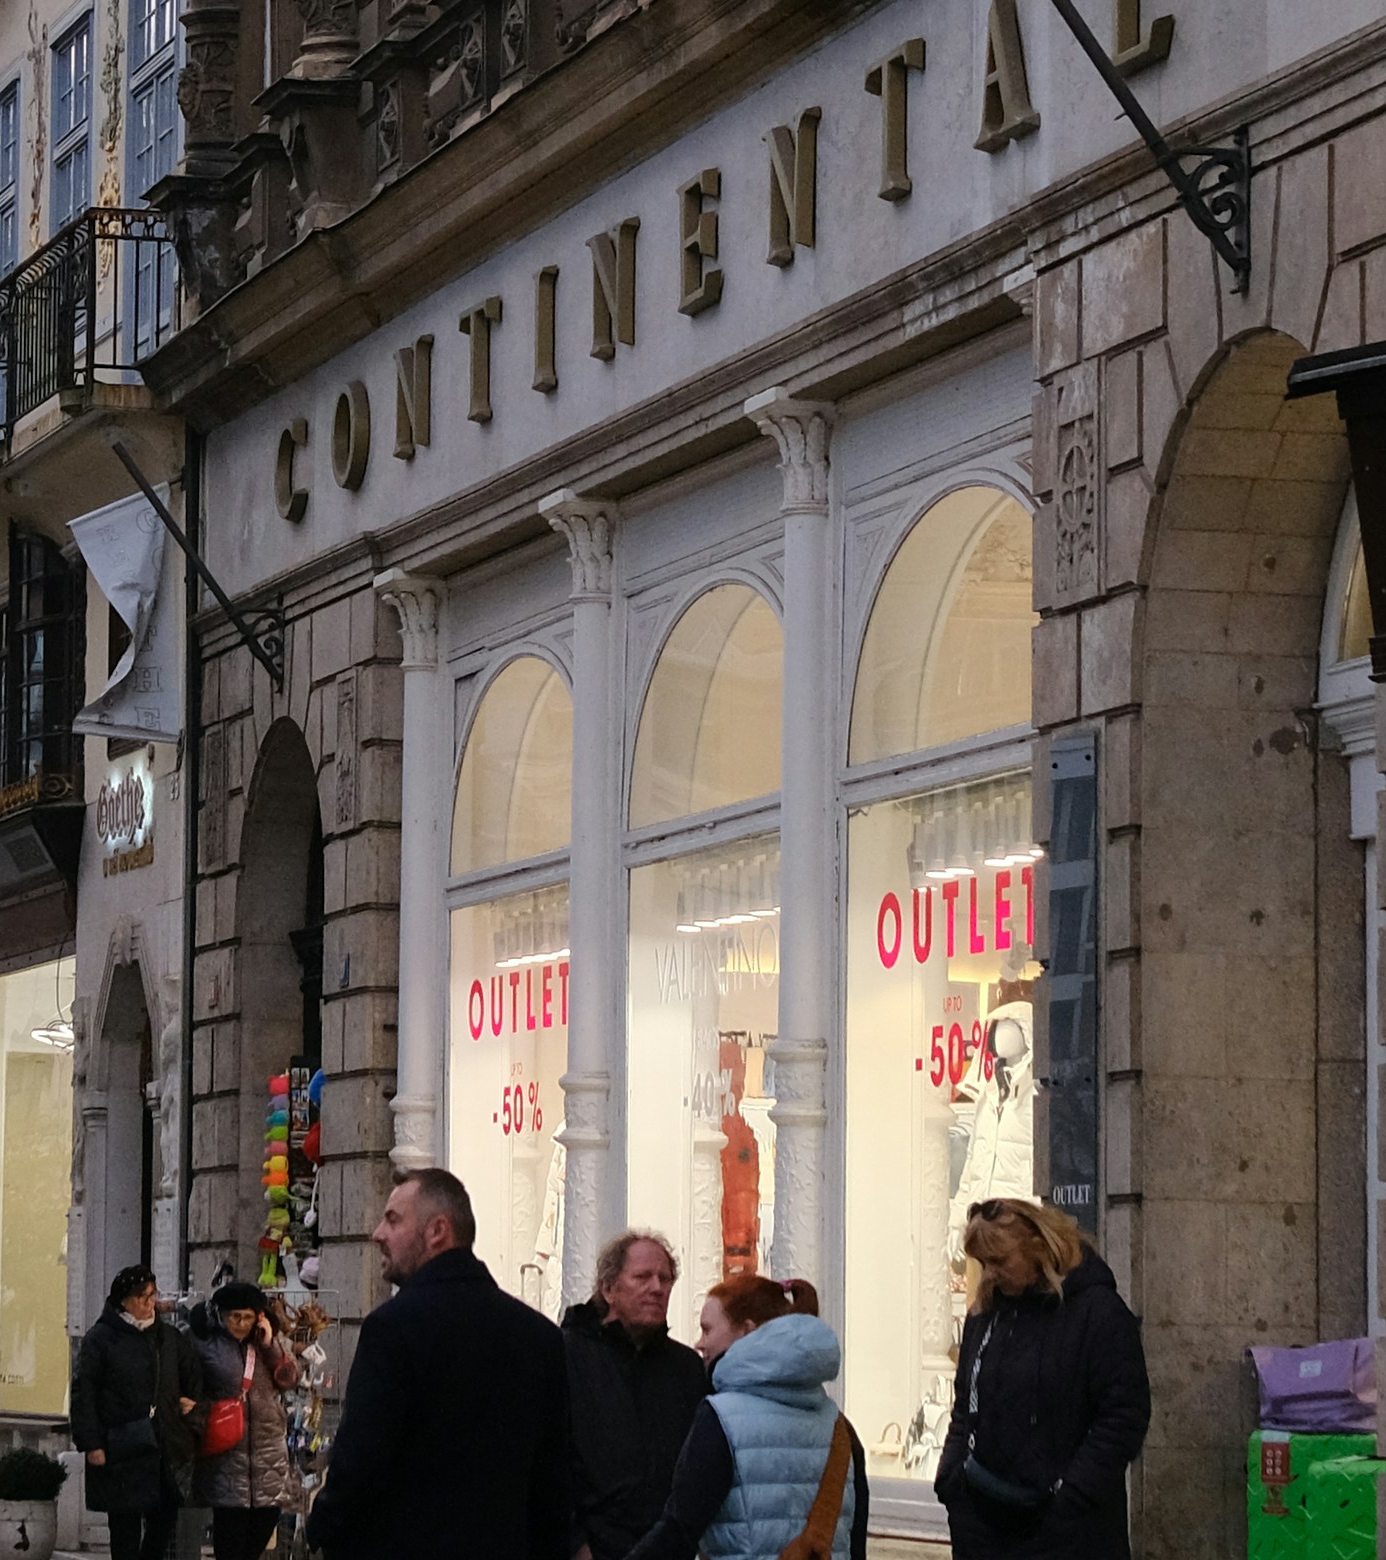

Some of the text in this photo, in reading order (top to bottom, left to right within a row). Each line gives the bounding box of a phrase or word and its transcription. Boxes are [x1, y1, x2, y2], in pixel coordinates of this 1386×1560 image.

[97, 769, 145, 844] Goethe
[877, 866, 1034, 970] OUTLET
[468, 962, 570, 1041] OUTLET
[655, 921, 779, 1005] VALENTINO
[1053, 1183, 1091, 1205] OUTLET
